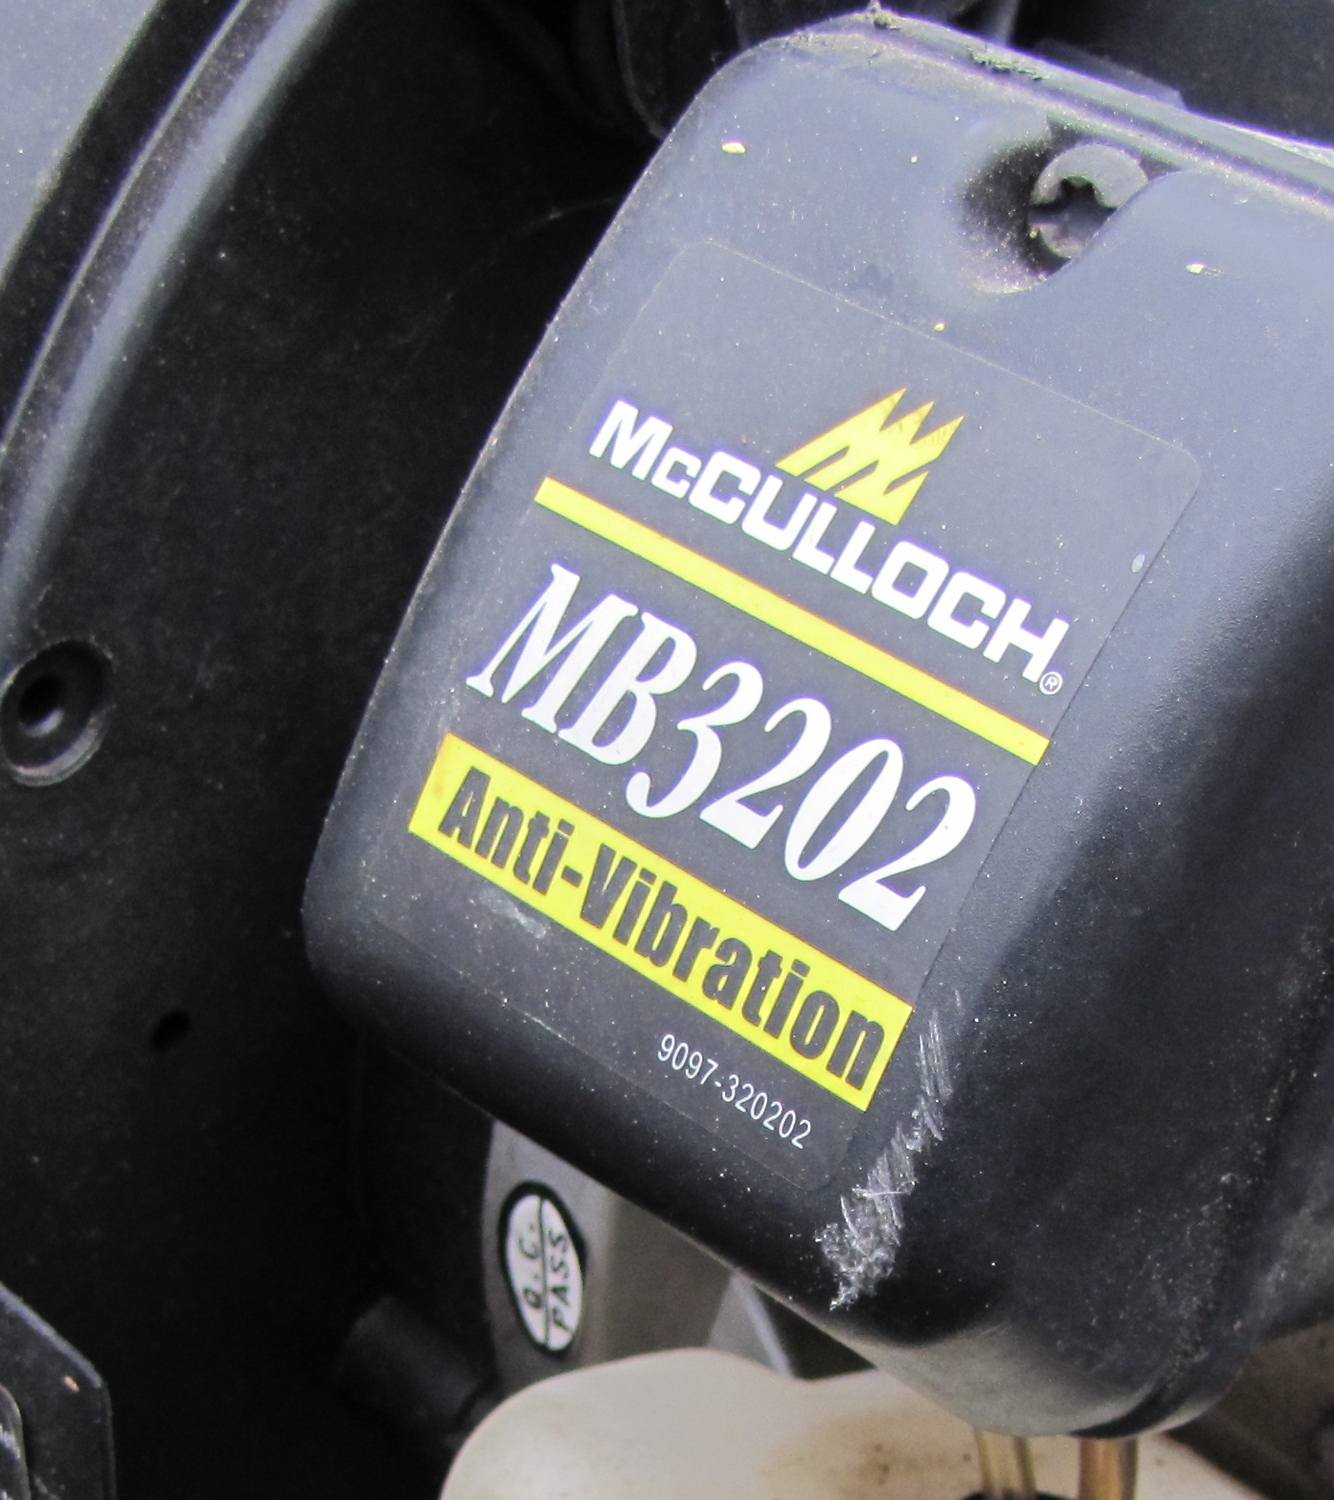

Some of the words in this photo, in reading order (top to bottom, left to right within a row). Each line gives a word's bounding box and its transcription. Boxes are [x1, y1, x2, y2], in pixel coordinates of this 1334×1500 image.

[466, 563, 978, 933] MB3202
[438, 765, 888, 1091] Anti-Vibration
[655, 1032, 813, 1150] 9097-320202
[545, 1228, 573, 1333] PASS
